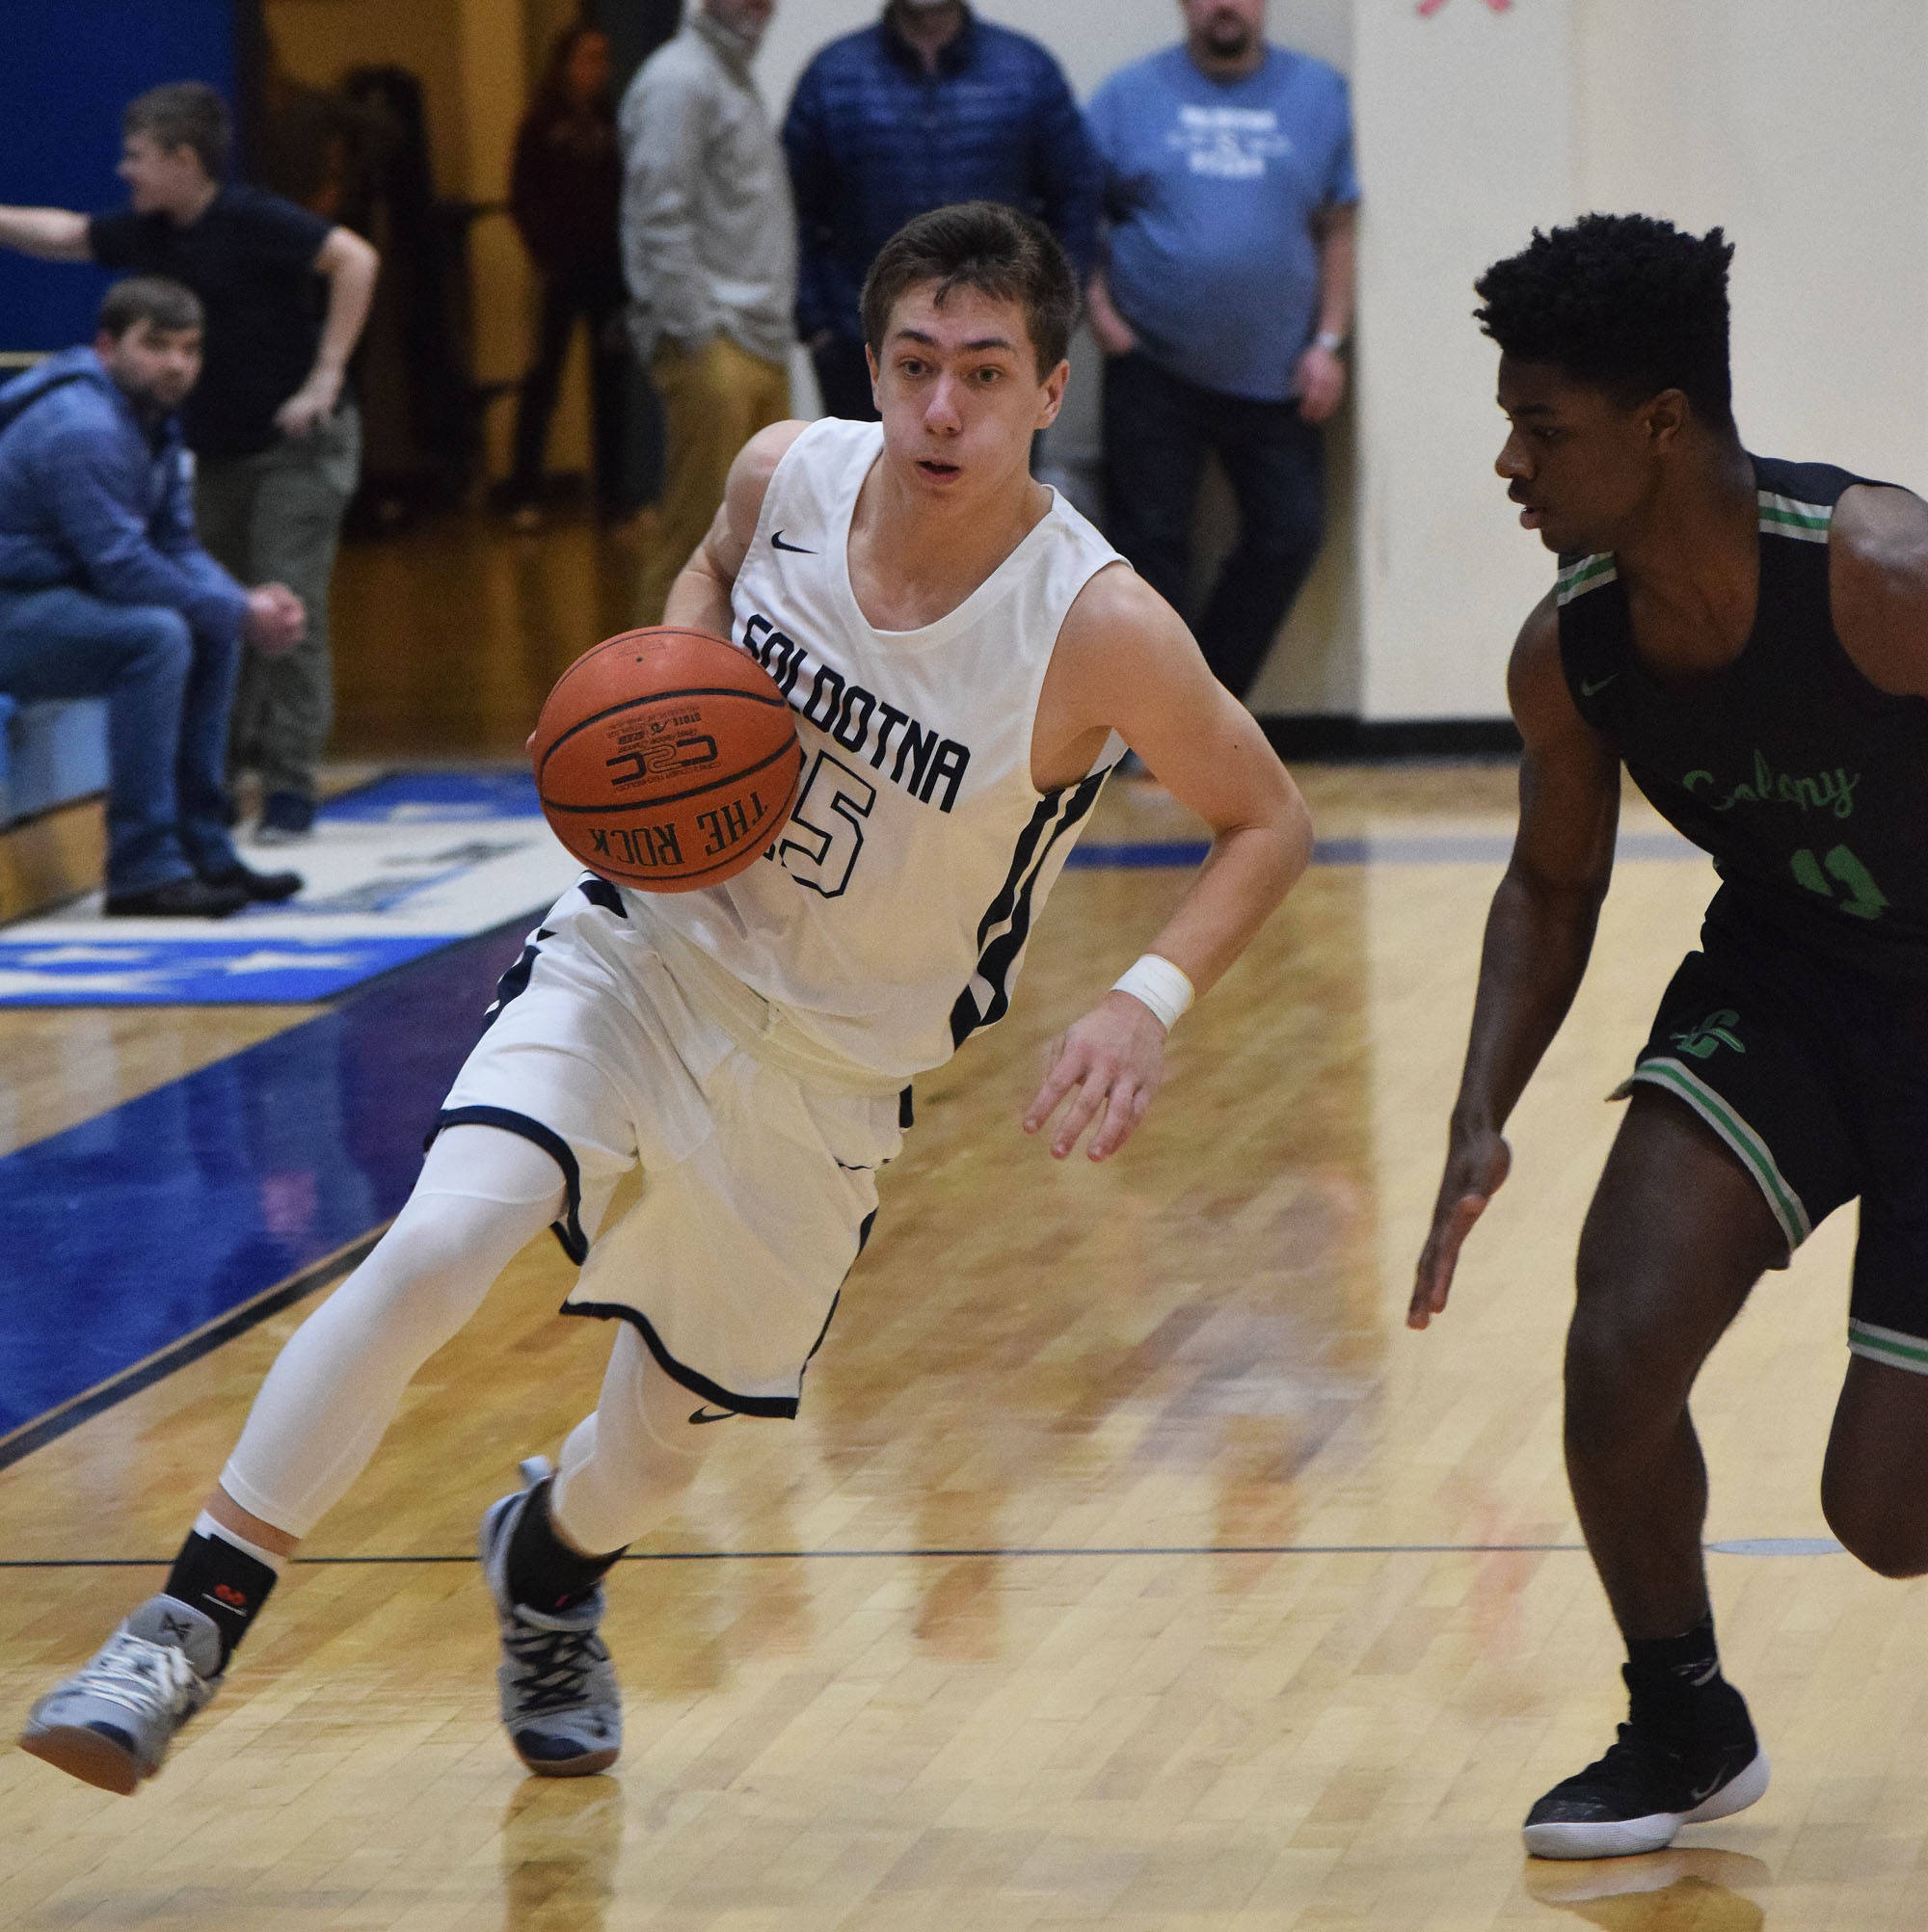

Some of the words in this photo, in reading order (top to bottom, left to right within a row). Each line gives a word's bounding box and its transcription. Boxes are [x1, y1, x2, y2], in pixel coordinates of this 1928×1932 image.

[605, 736, 718, 786] C2C
[588, 823, 685, 866] ROCK
[696, 792, 768, 856] THE
